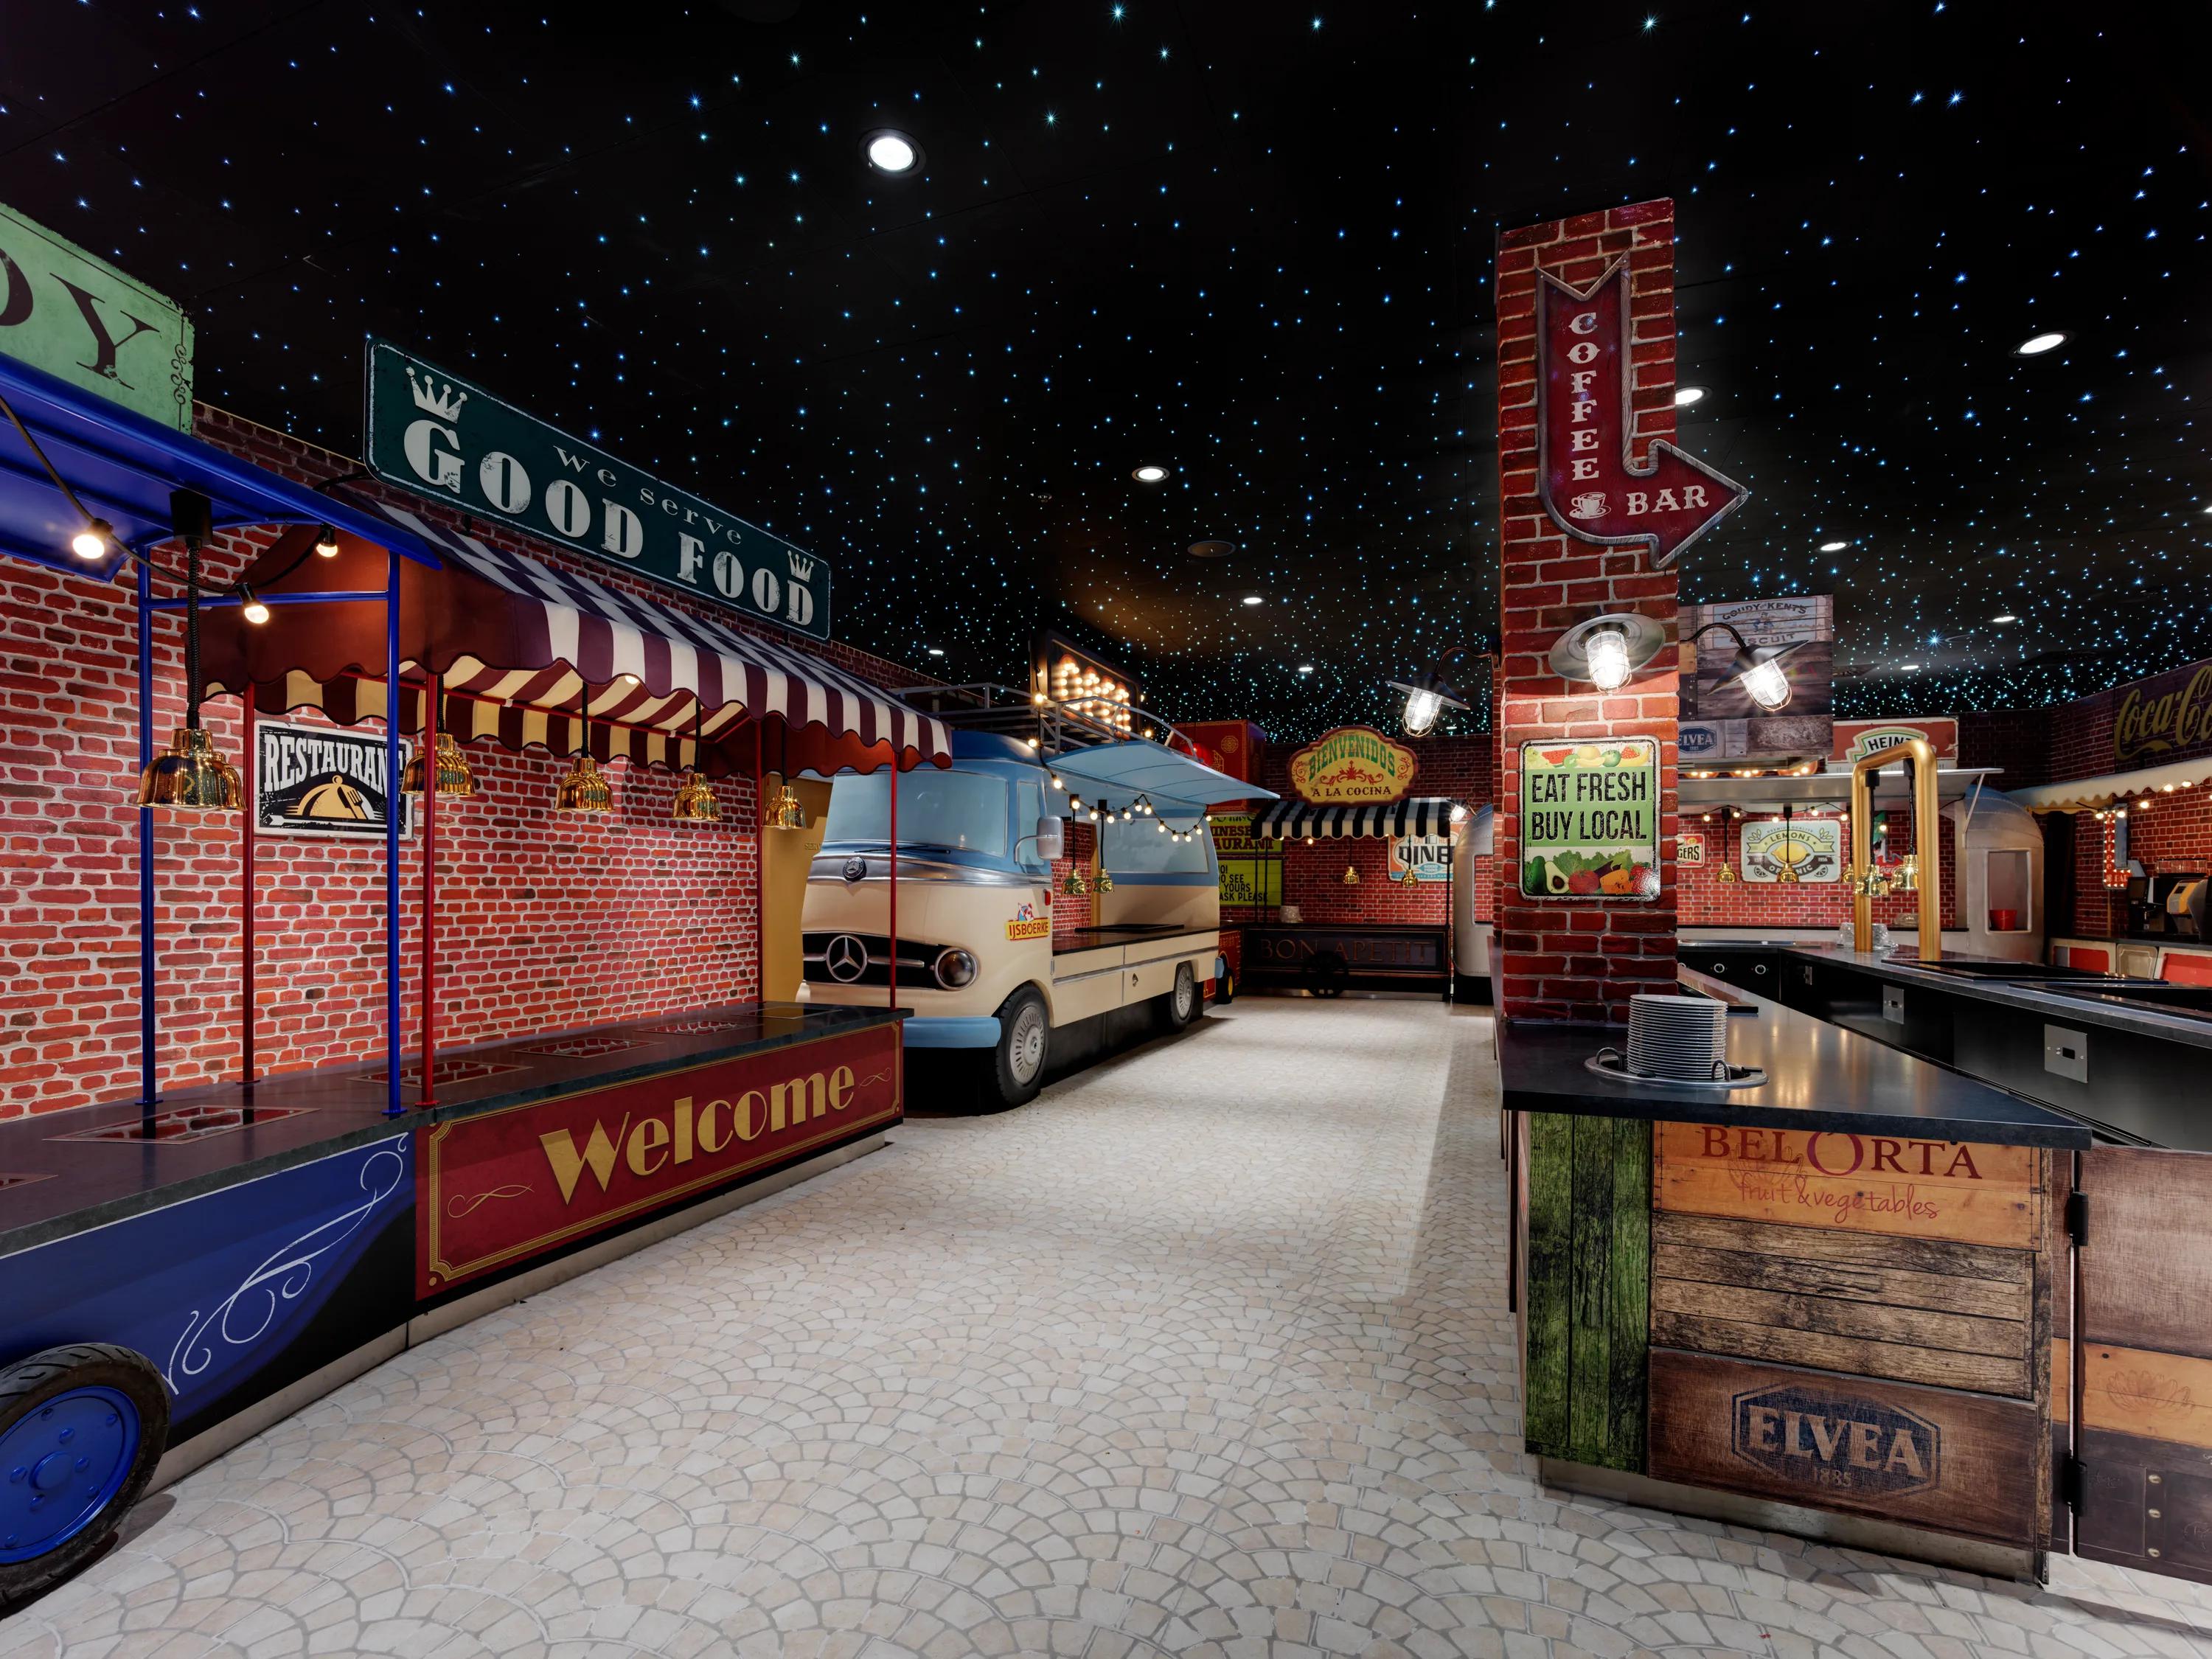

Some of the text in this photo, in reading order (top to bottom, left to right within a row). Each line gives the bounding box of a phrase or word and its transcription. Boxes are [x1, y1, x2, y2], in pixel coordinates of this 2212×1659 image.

[1566, 312, 1601, 481] COFFEE
[1625, 484, 1710, 516] BAR
[403, 419, 814, 626] GOOD FOOD
[639, 487, 742, 545] serve
[1730, 633, 1796, 644] BSCUIT
[1309, 735, 1395, 782] BIENVENIDOS
[1326, 788, 1341, 796] LA
[1346, 786, 1392, 796] COCINA
[1531, 771, 1646, 803] EAT FRESH
[1531, 810, 1647, 841] BUY LOCAL
[1770, 832, 1811, 842] LEMONS
[1229, 874, 1245, 883] SEE
[1768, 865, 1813, 874] ORNIC
[1224, 883, 1251, 892] YOURS
[1009, 922, 1049, 939] IJSBOERKE
[1260, 939, 1431, 963] BON APETIT
[538, 1065, 855, 1206] Welcome
[1747, 1404, 1928, 1479] ELVEA
